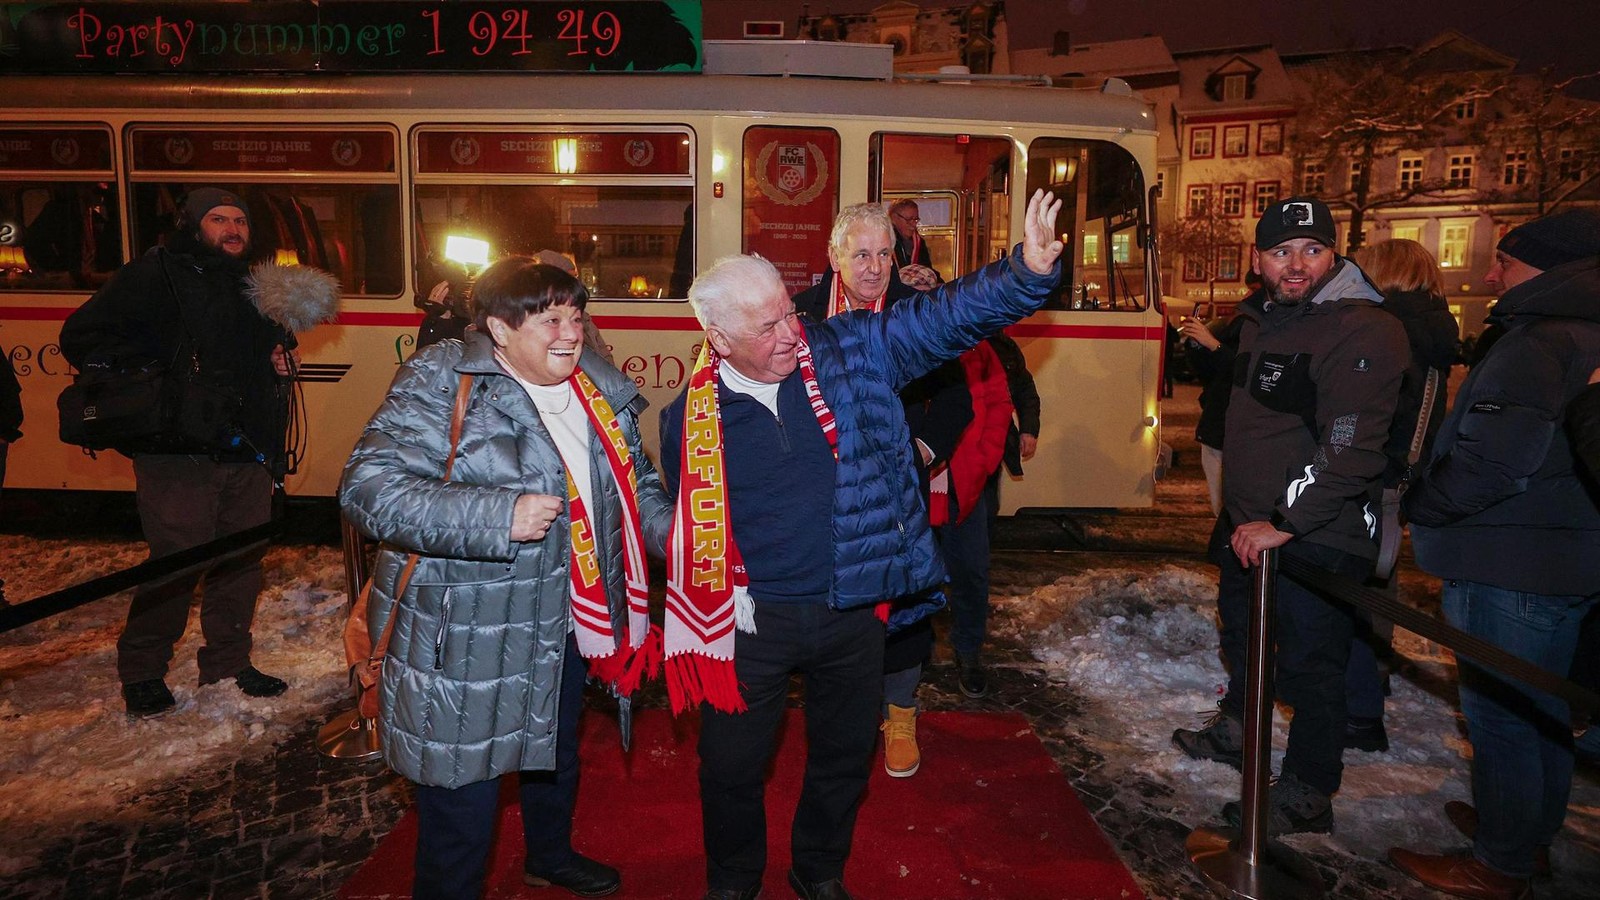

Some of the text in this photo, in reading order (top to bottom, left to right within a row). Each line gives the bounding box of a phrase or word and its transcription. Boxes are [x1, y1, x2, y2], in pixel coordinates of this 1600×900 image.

[422, 9, 445, 56] 1
[468, 9, 533, 57] 94
[557, 9, 621, 57] 49
[0, 141, 32, 151] AHRE
[212, 141, 311, 152] SECHZIG JAHRE
[500, 141, 554, 152] SECHZI
[785, 147, 799, 156] FC
[780, 156, 804, 164] RWE
[760, 222, 821, 231] SECHZIG JAHRE
[686, 380, 727, 593] ERFURT
